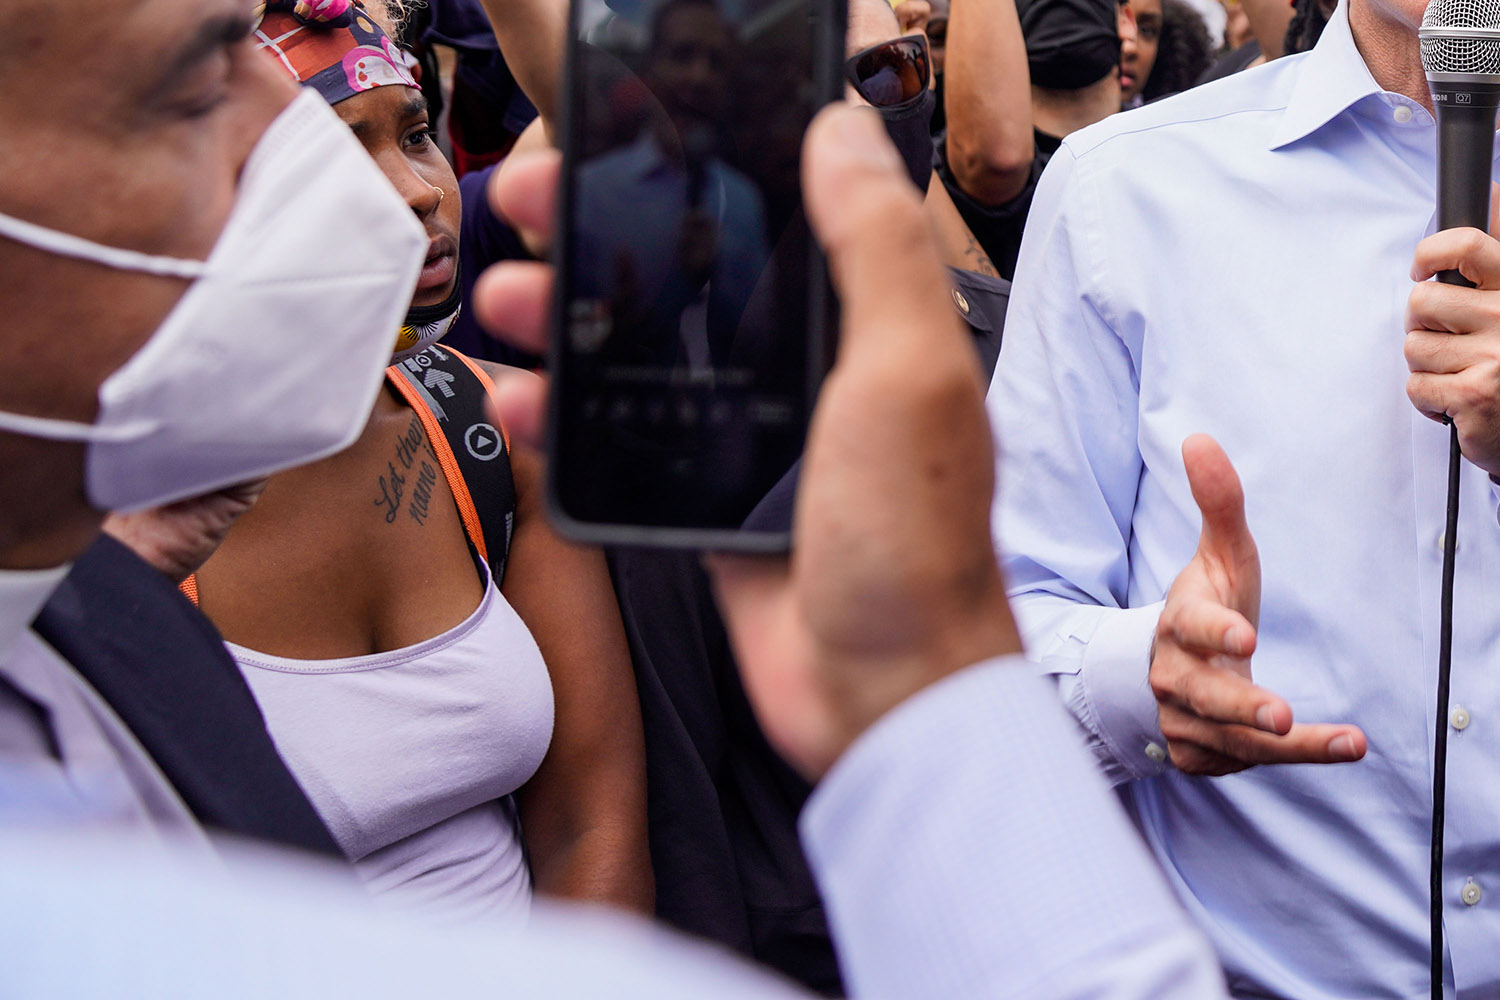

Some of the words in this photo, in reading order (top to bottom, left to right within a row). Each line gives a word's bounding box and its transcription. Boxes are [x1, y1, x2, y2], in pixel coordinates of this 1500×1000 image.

[1431, 93, 1448, 102] SON
[1456, 94, 1471, 103] Q7
[374, 461, 406, 523] Let
[408, 461, 436, 526] name
